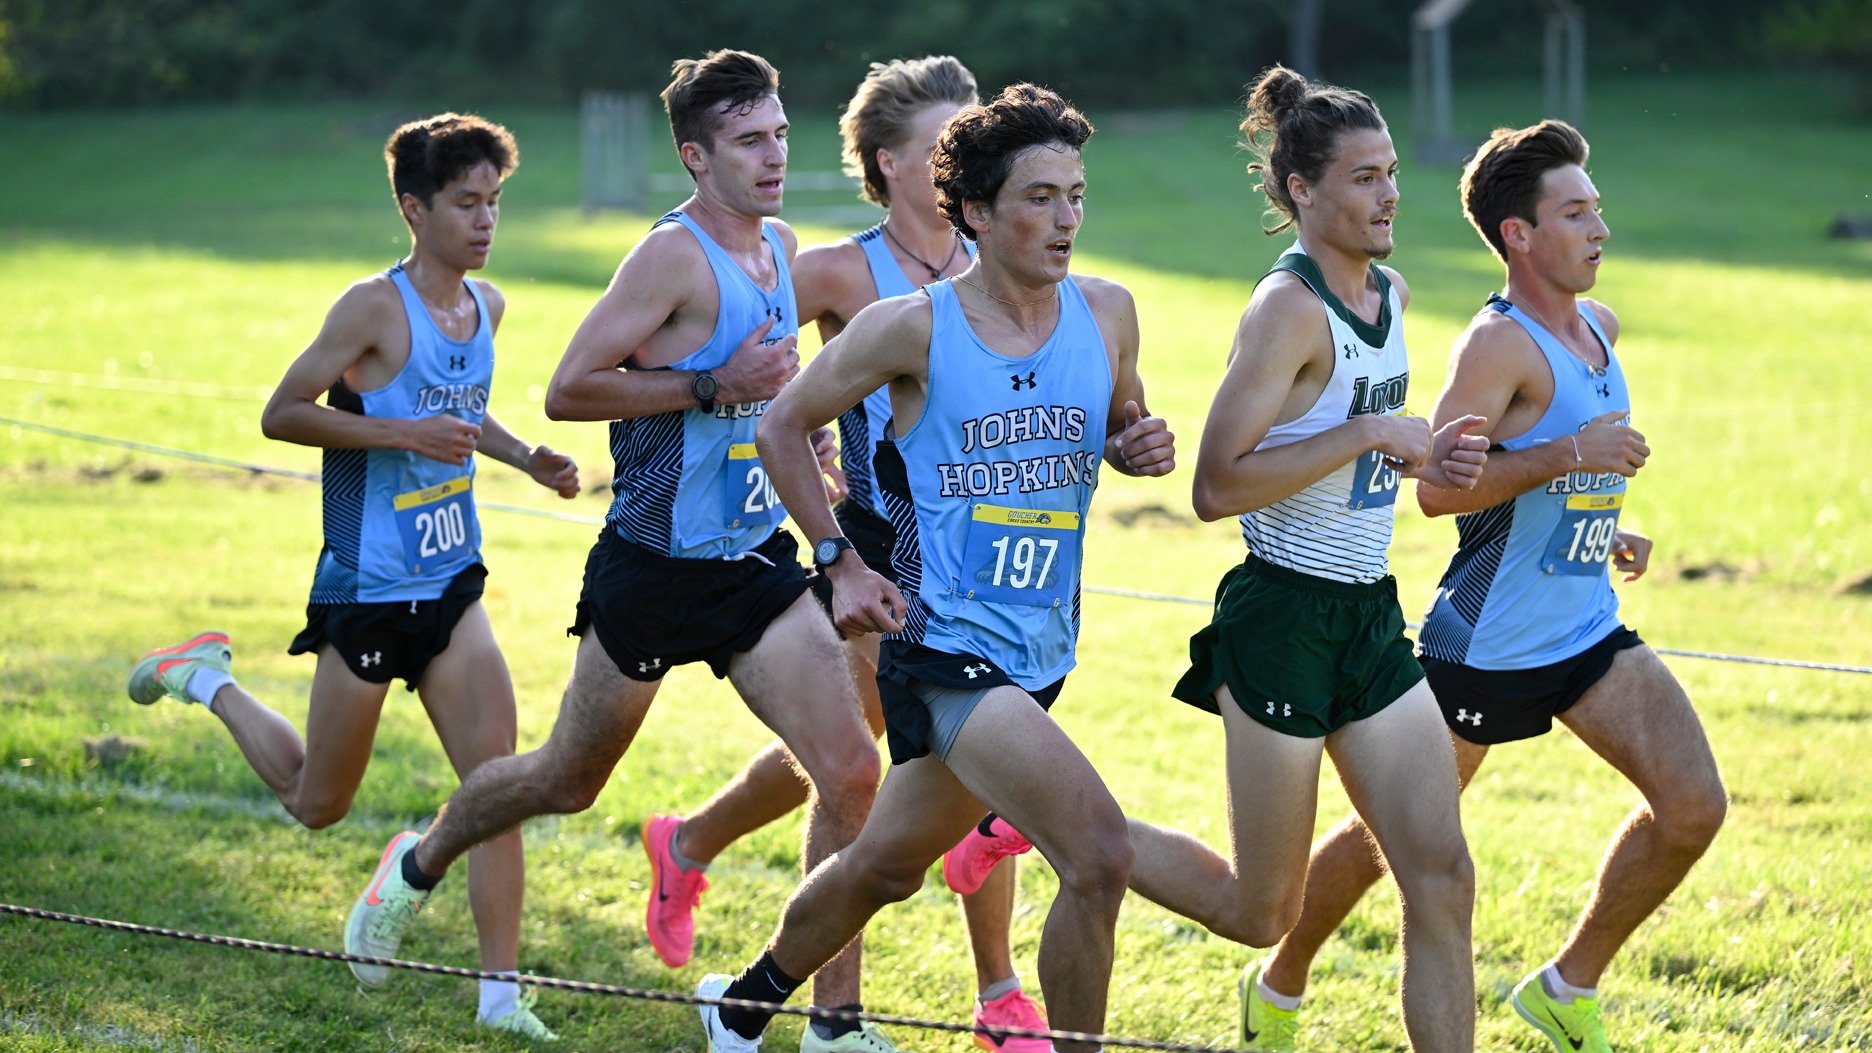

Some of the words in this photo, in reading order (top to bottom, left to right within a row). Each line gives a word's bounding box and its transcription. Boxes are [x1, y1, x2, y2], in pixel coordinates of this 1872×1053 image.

[413, 383, 488, 416] JOHNS
[961, 405, 1086, 454] JOHNS
[937, 450, 1095, 498] HOPKINS
[415, 502, 466, 558] 200
[1007, 510, 1038, 520] GOUCHER
[992, 535, 1059, 590] 197
[1567, 517, 1615, 563] 199
